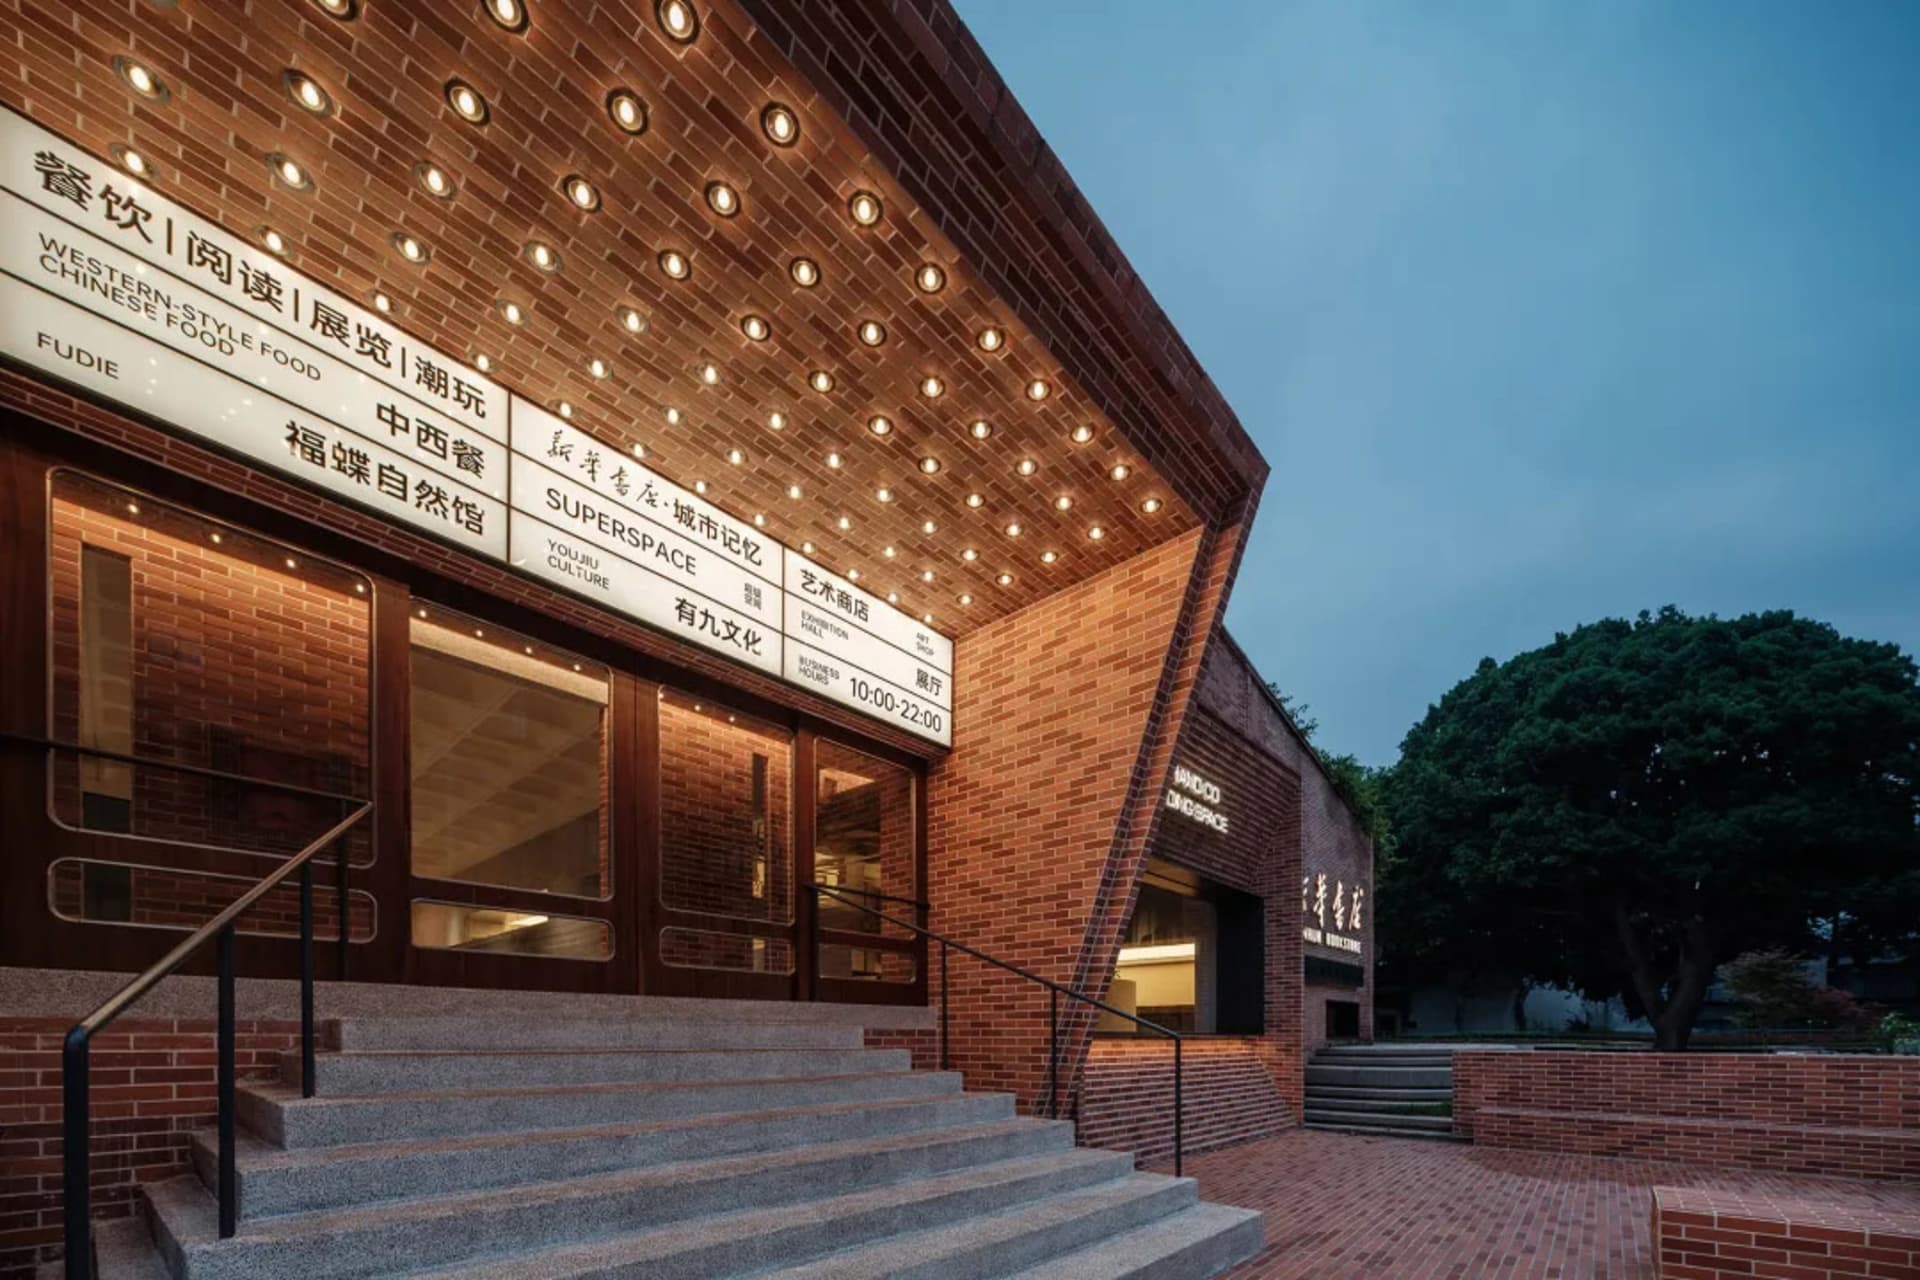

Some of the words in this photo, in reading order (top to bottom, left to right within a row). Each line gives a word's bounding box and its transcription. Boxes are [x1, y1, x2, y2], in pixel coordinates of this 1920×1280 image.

[38, 232, 253, 352] WESTERN-STYLE
[261, 341, 321, 382] FOOD
[39, 254, 157, 322] CHINESE
[166, 312, 235, 357] FOOD
[37, 332, 119, 380] FUDIE
[377, 402, 485, 480] 中西餐
[285, 421, 485, 536] 福蝶自然馆
[546, 488, 696, 576] SUPERSPACE
[547, 539, 599, 571] YOUJIU
[547, 556, 610, 590] CULTURE
[800, 568, 869, 622] 艺术商店
[675, 597, 762, 656] 有九文化
[801, 610, 849, 640] EXHIBITION
[801, 620, 824, 640] HALL
[799, 656, 840, 680] BUSINESS
[799, 668, 830, 686] HOURS
[915, 667, 943, 697] 展厅
[849, 677, 942, 732] 10:00-22:00
